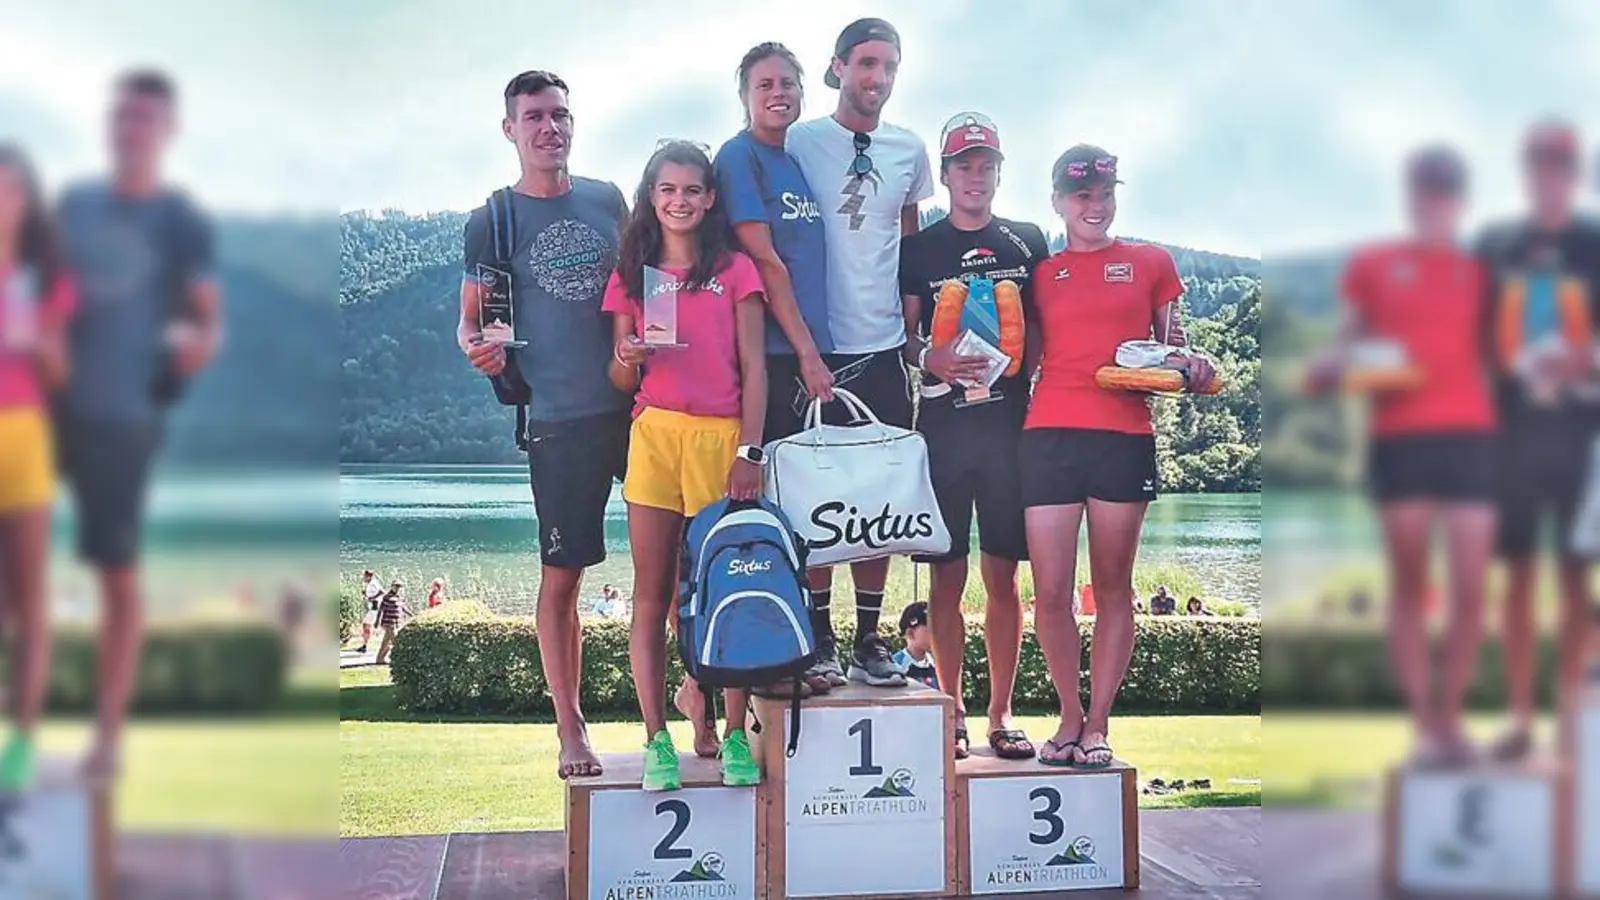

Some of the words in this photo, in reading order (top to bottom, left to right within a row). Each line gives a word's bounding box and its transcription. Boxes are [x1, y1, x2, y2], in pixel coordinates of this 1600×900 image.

[548, 253, 598, 269] cocoon
[804, 501, 933, 548] Sixtus
[727, 558, 771, 576] Sixtus
[848, 718, 883, 776] 1
[802, 800, 927, 816] ALPENTRIATHLON
[1029, 787, 1065, 844] 3
[653, 799, 692, 859] 2
[987, 866, 1108, 884] ALPENTRIATHLON
[605, 883, 738, 900] ALPENTRIATHLON
